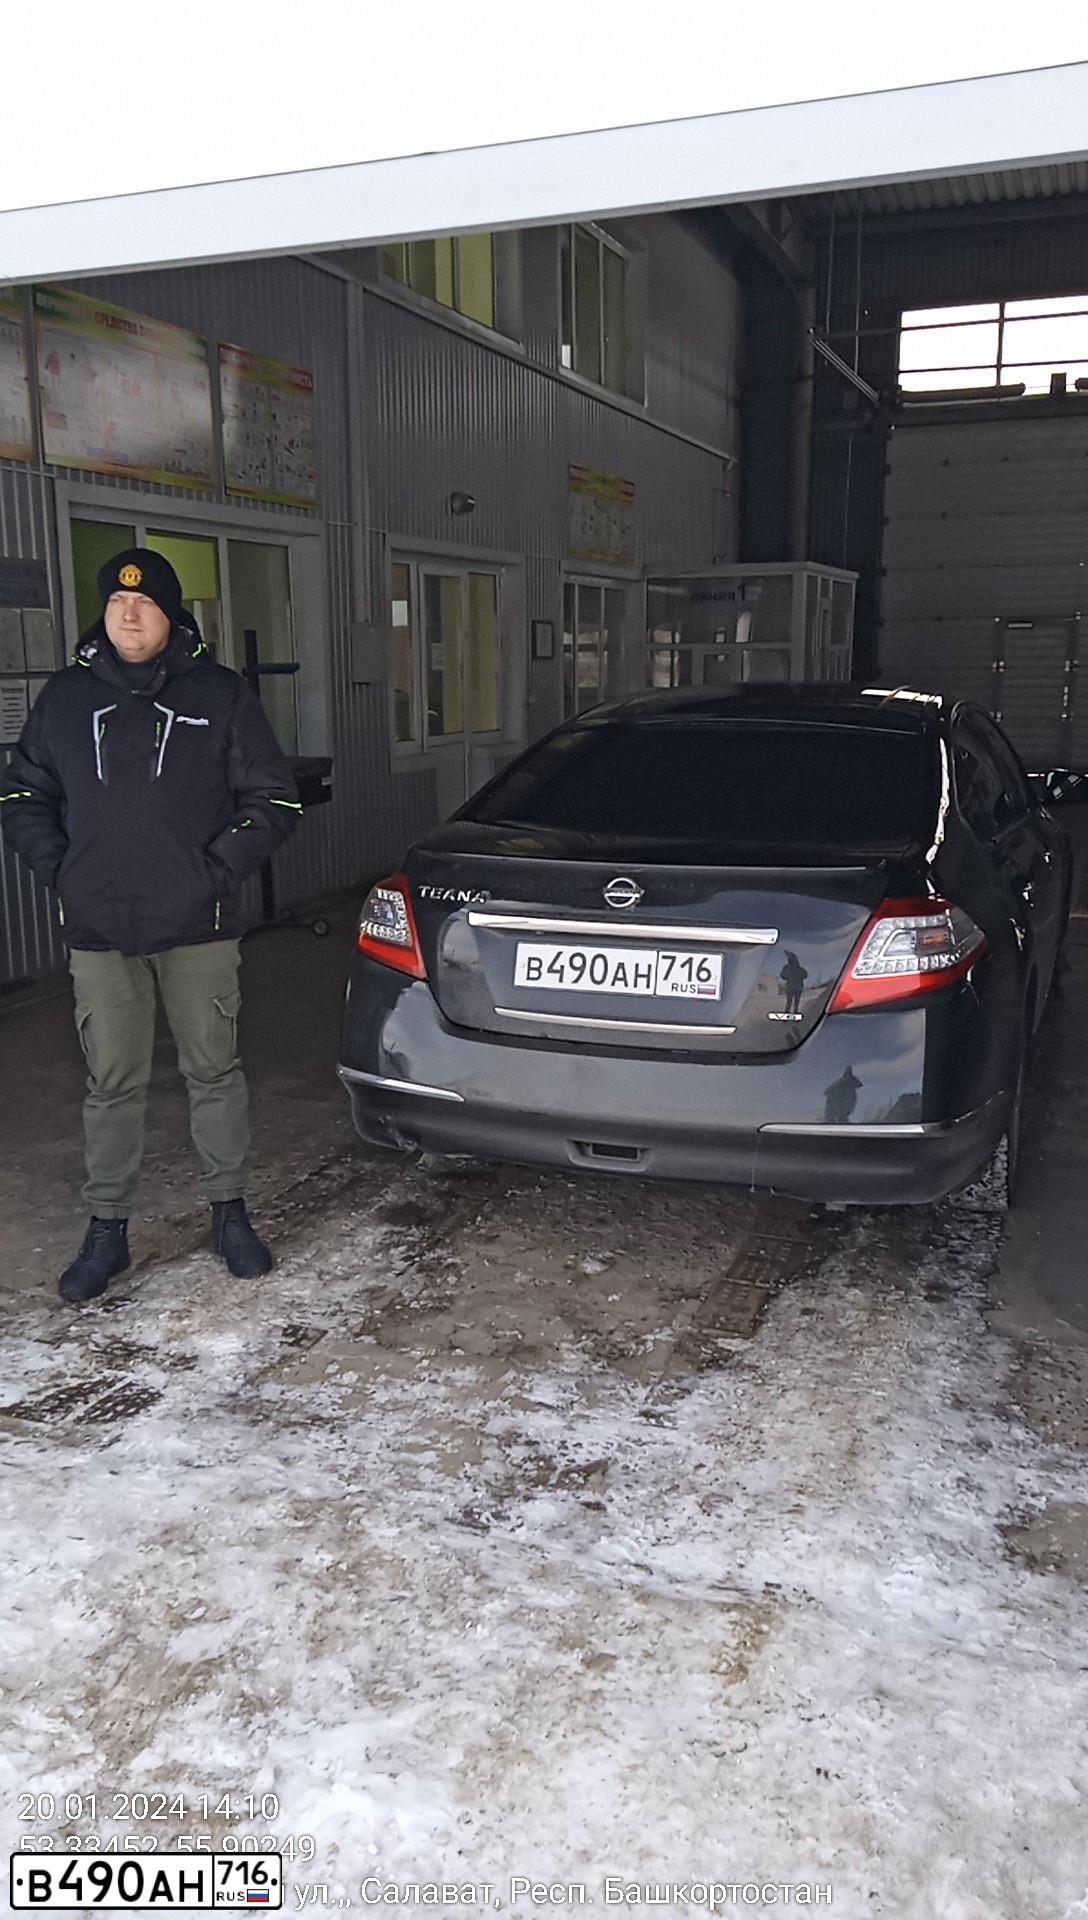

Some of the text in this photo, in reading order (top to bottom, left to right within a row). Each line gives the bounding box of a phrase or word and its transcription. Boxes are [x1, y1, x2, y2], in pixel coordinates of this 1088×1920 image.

[418, 885, 487, 904] TEANA
[661, 955, 713, 983] 716
[671, 982, 697, 994] RUS
